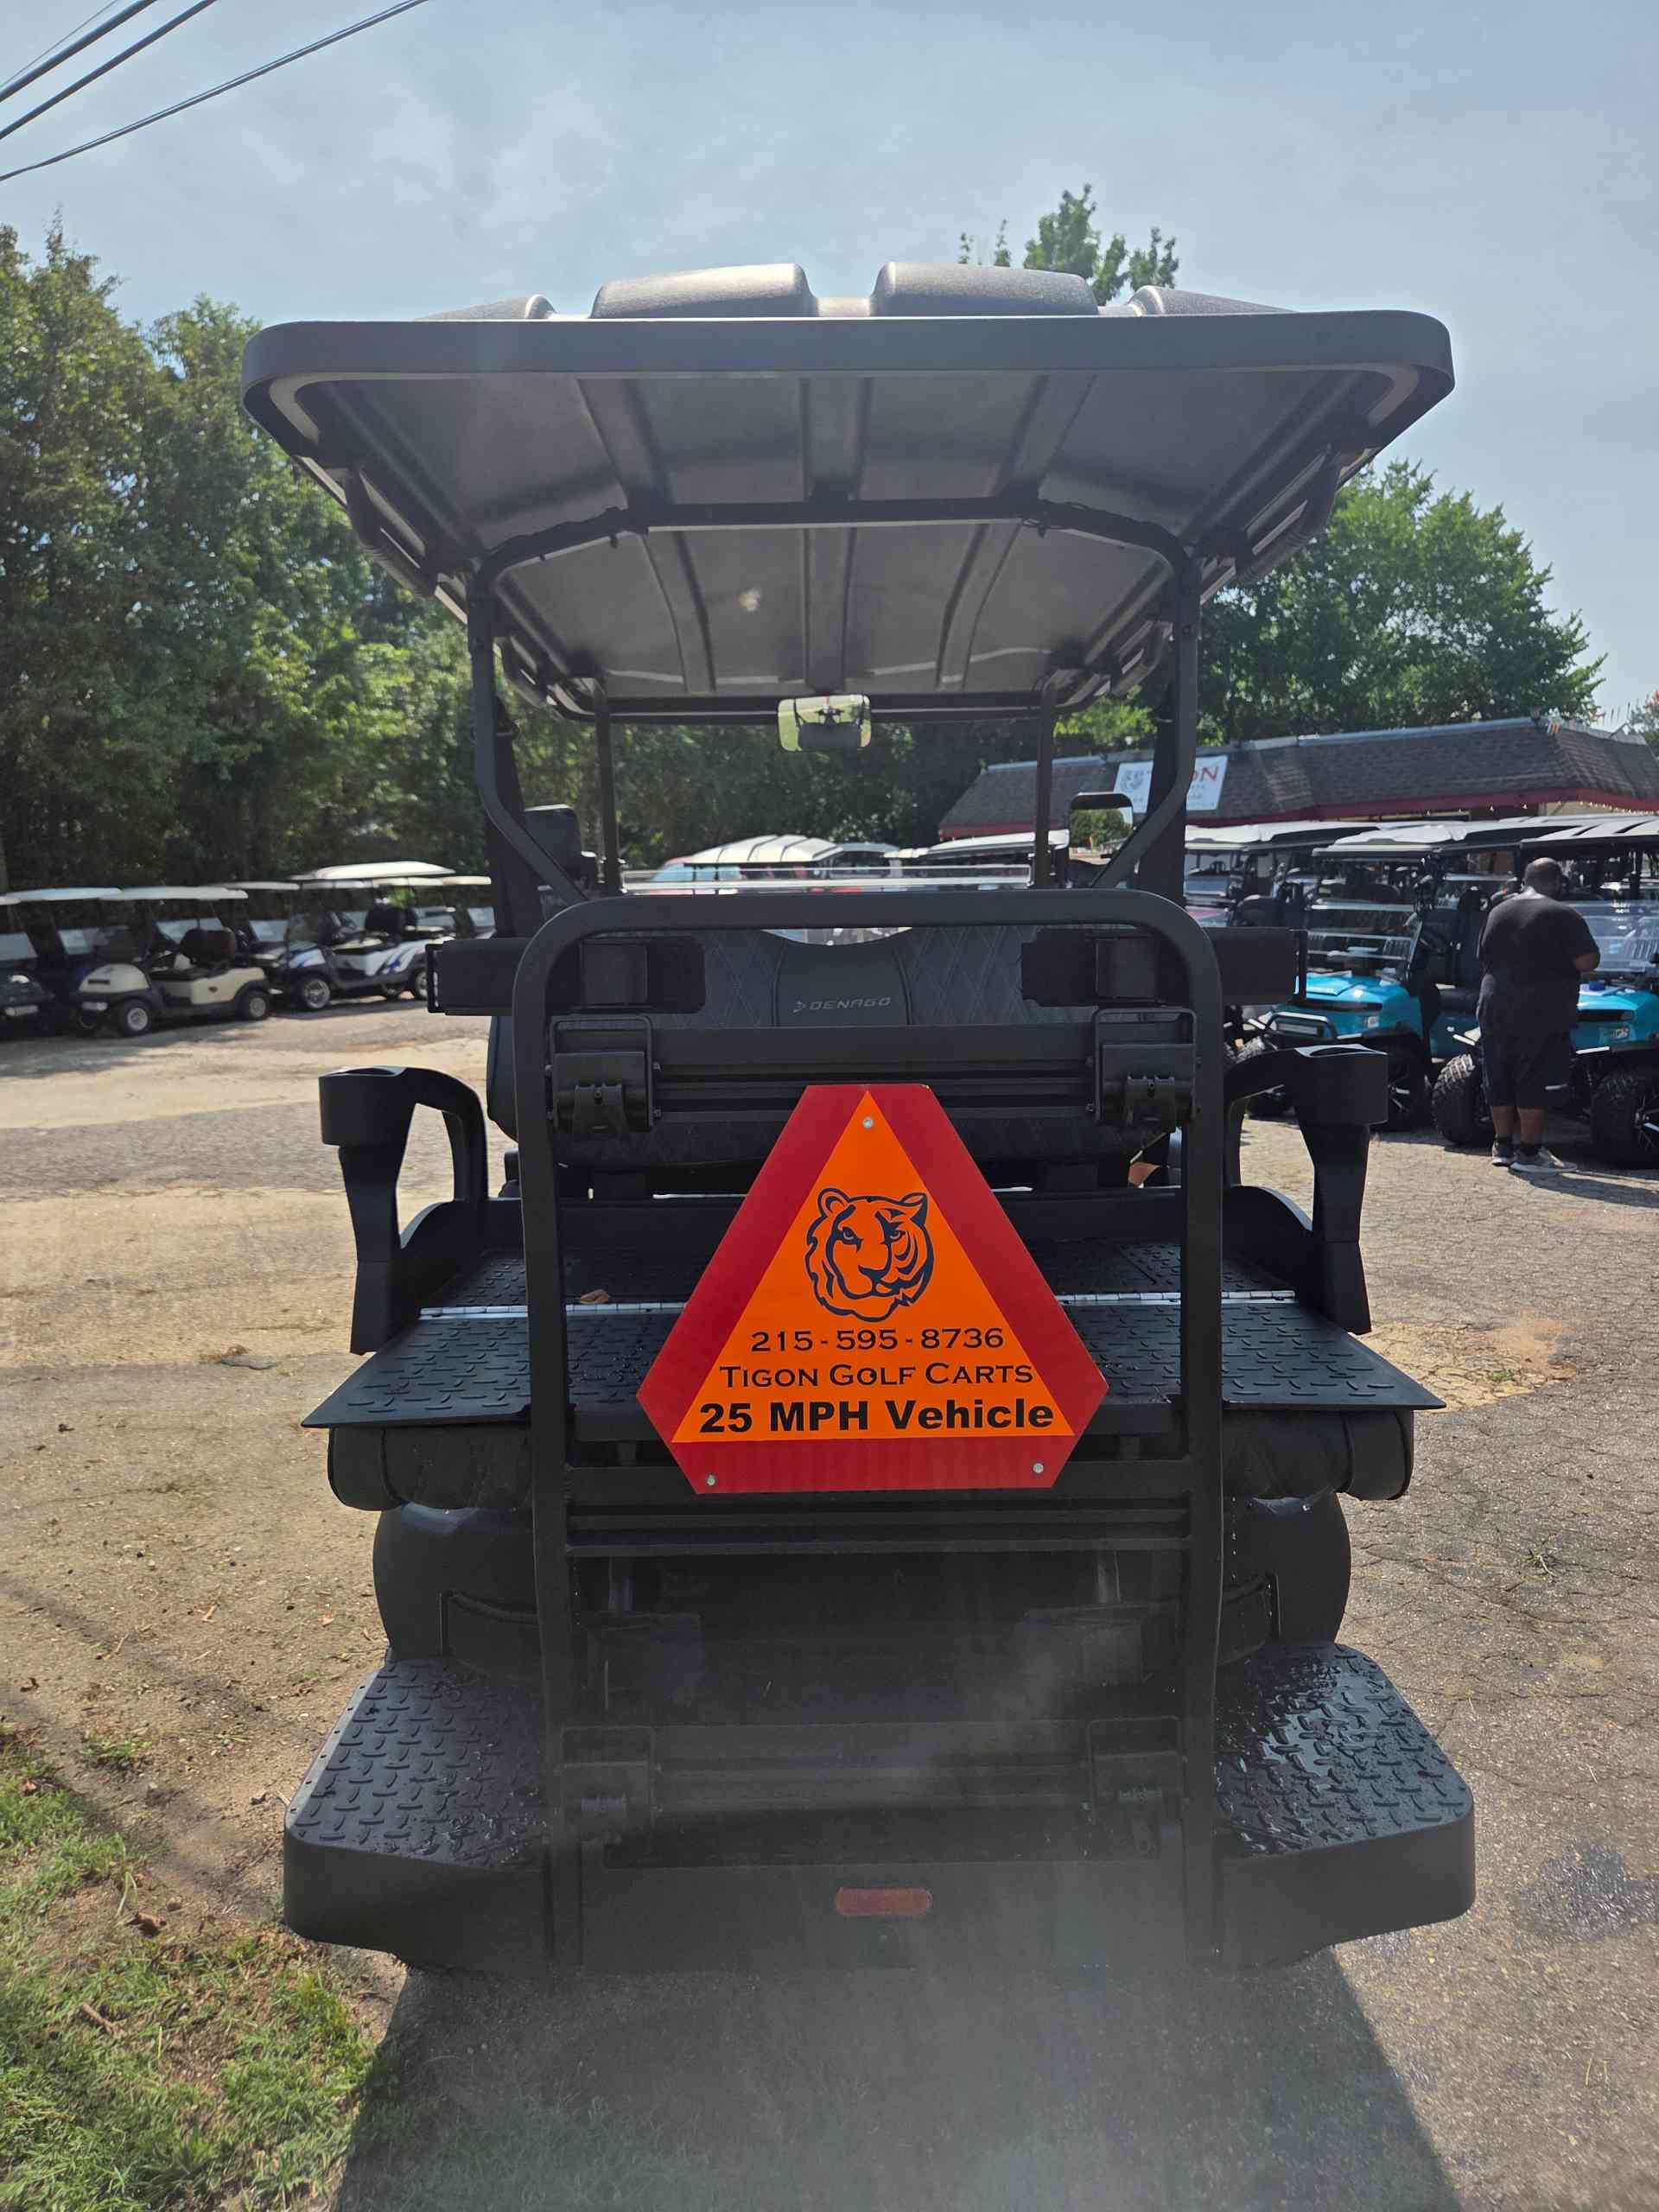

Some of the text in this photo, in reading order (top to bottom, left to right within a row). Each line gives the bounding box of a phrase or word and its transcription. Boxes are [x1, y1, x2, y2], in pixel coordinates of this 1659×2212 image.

[809, 996, 892, 1010] DENAGO
[720, 1363, 1033, 1388] TIGON GOLF CARTS
[700, 1399, 1054, 1433] 25 MPH Vehicle
